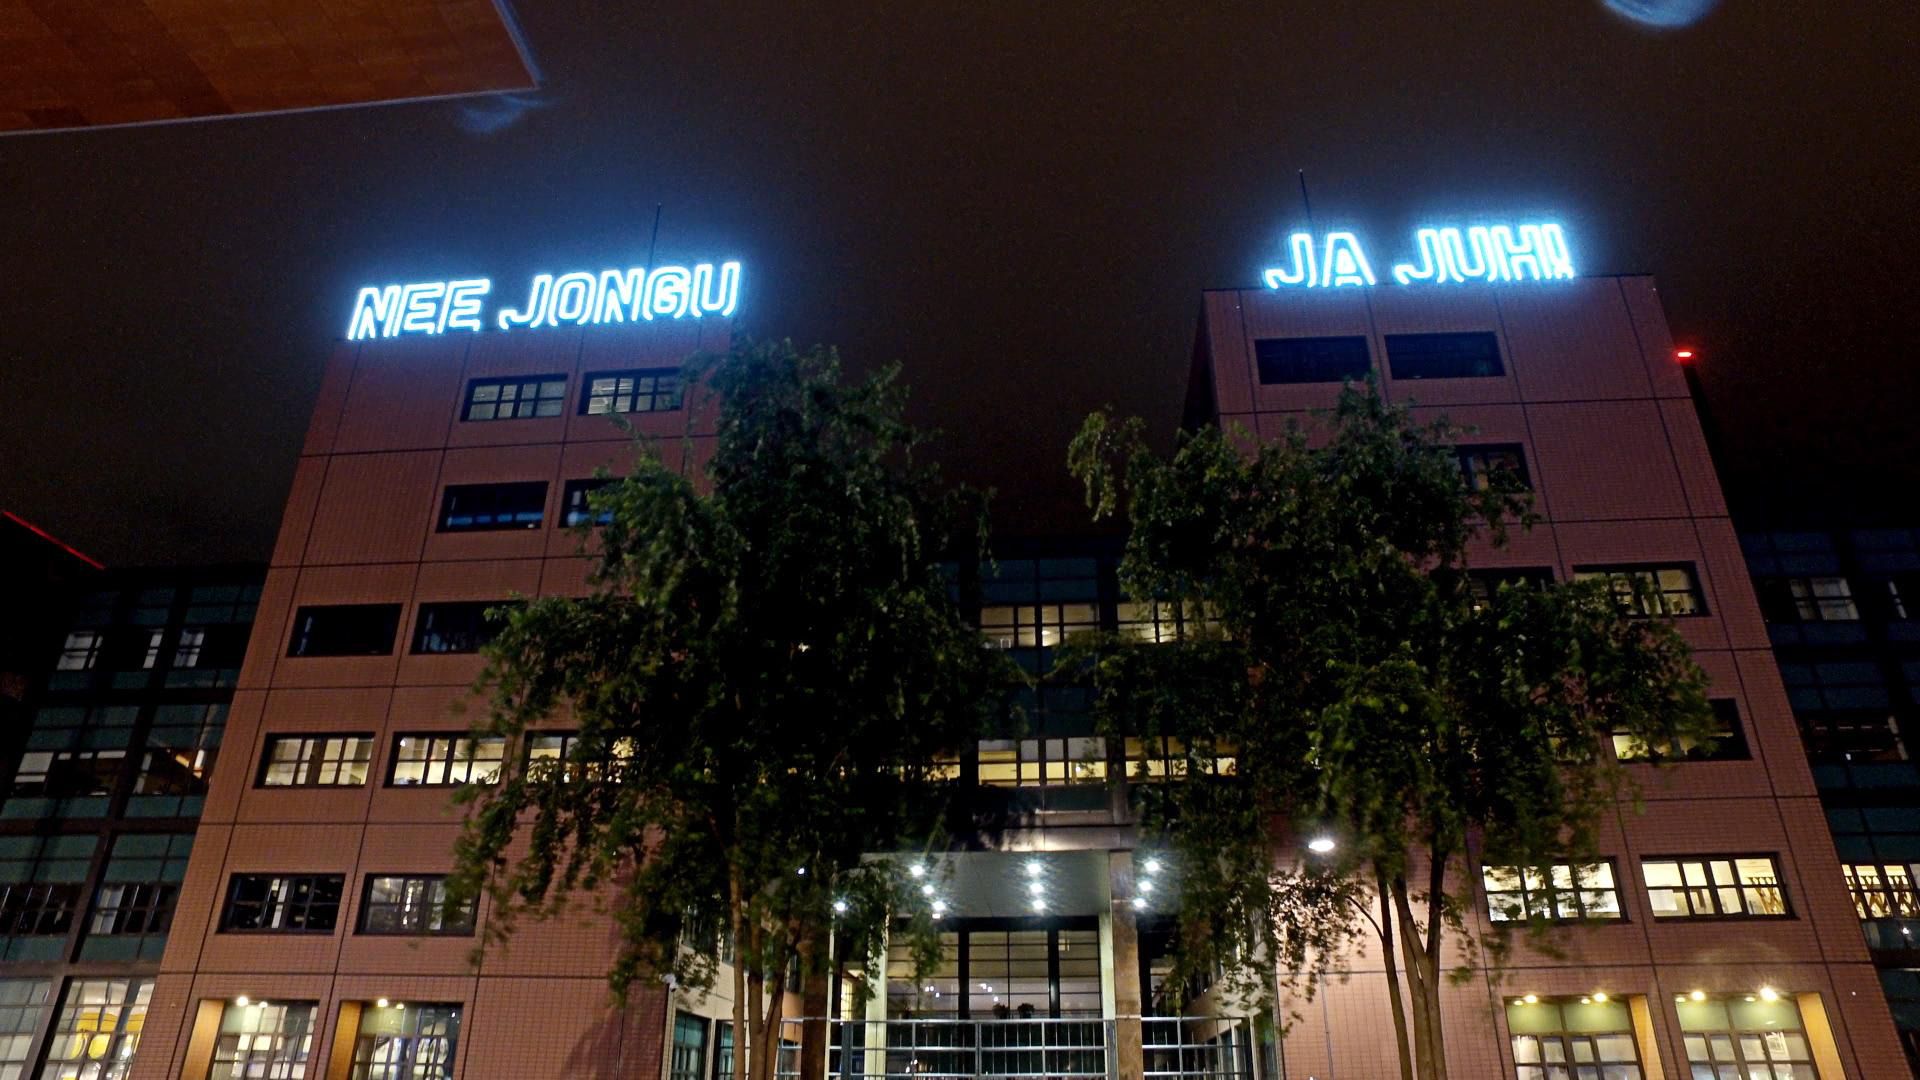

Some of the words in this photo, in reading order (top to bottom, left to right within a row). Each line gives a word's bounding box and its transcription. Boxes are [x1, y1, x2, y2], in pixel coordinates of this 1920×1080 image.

[1264, 231, 1376, 289] JA
[347, 278, 490, 340] NEE
[498, 261, 740, 329] JONGU
